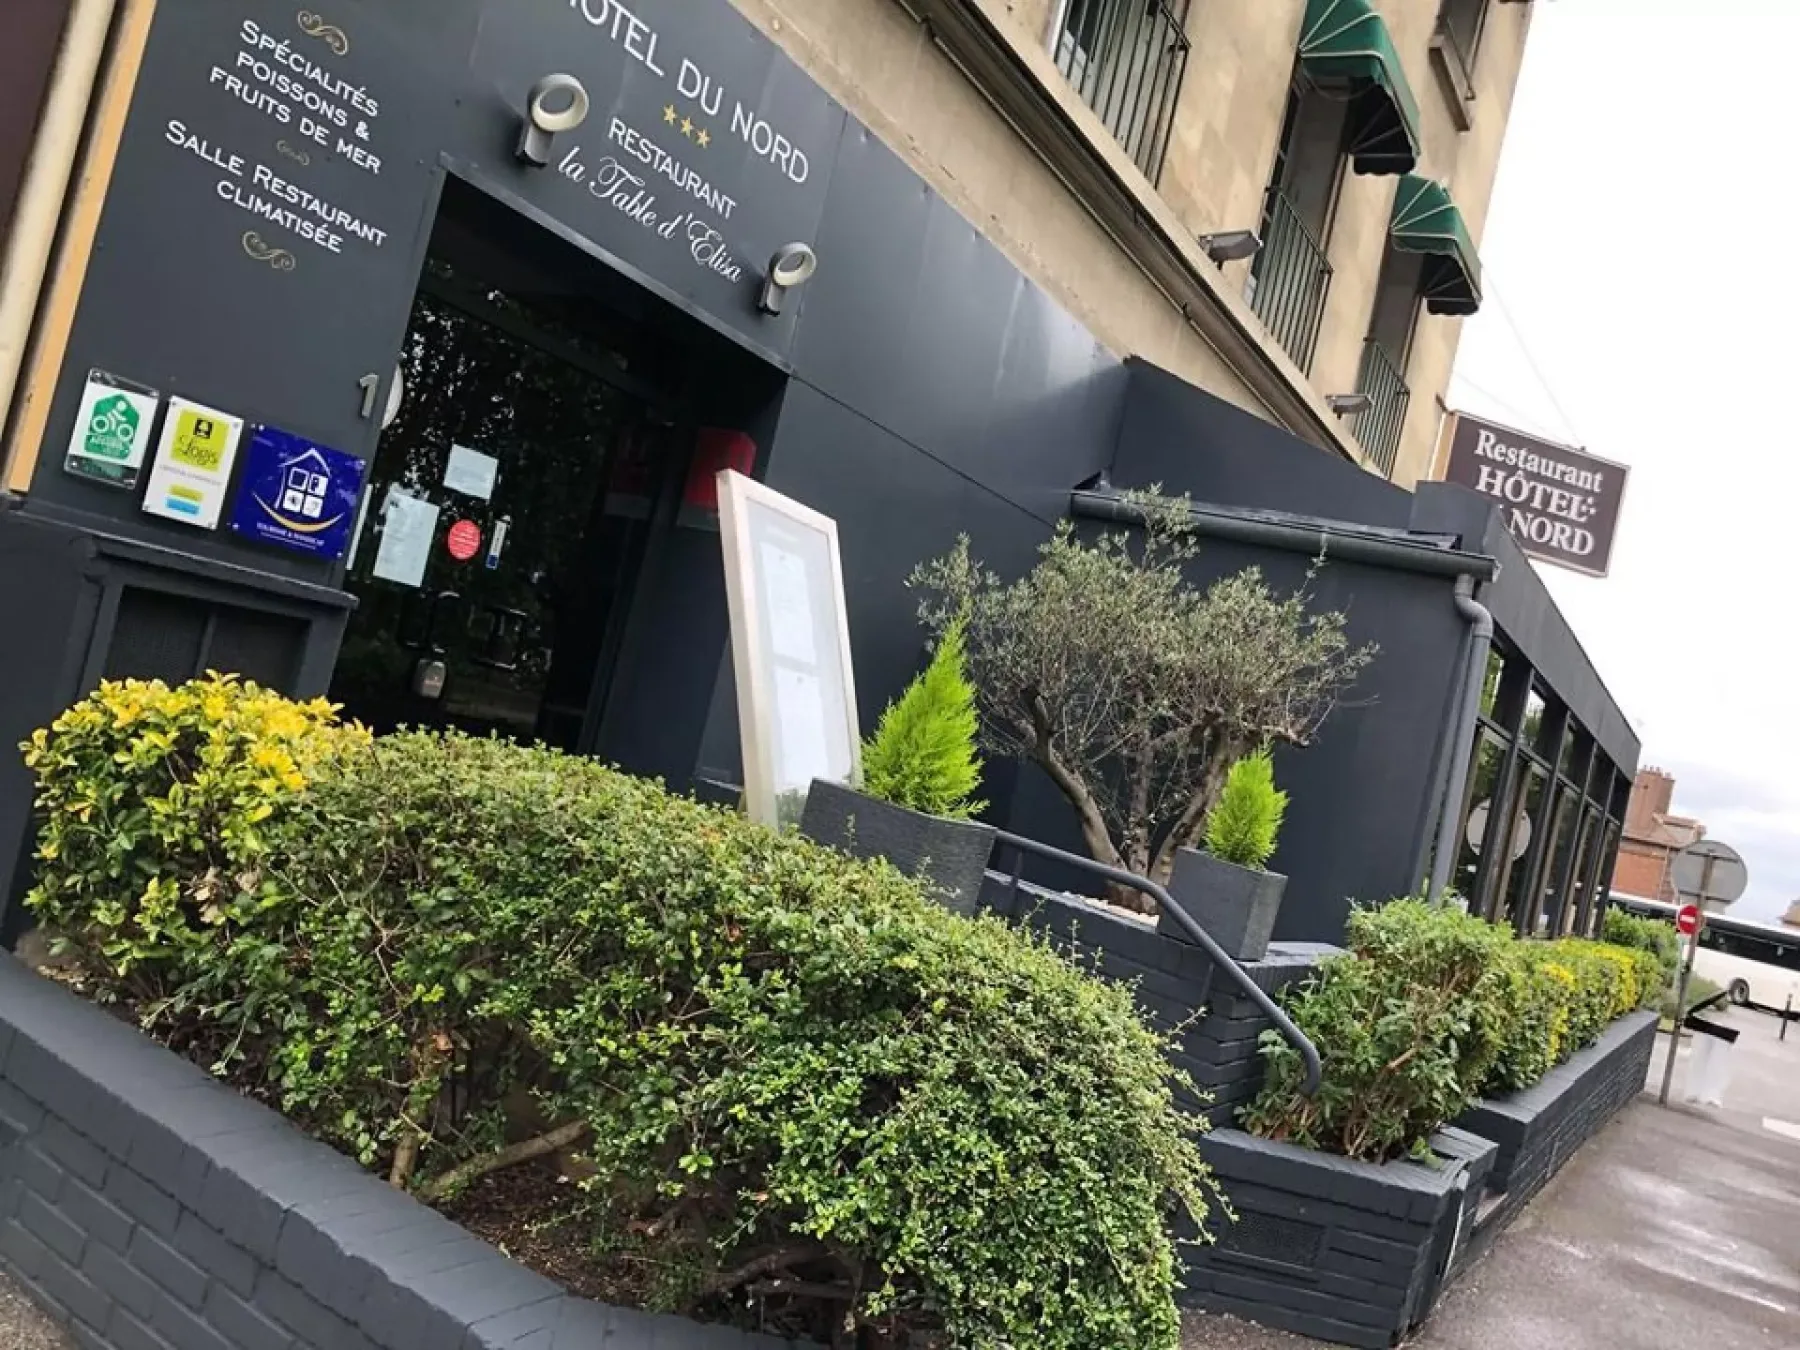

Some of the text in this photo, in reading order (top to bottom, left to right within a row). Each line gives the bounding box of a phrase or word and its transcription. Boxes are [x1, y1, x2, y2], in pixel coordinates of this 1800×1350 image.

[236, 51, 369, 141] POISSONS &
[239, 19, 379, 118] SPÉCIALITÉS
[569, 0, 809, 184] OTEL DU NORD
[209, 66, 382, 174] FRUITS DE MER
[164, 119, 388, 246] SALLE RESTAURANT
[557, 146, 586, 182] la
[588, 156, 656, 228] Table
[608, 117, 737, 219] RESTAURANT
[216, 180, 344, 254] CLIMATISÉE
[359, 373, 380, 418] 1
[1473, 428, 1603, 493] Restaurant
[1474, 465, 1589, 522] HÔTEL
[1510, 507, 1595, 556] NORD
